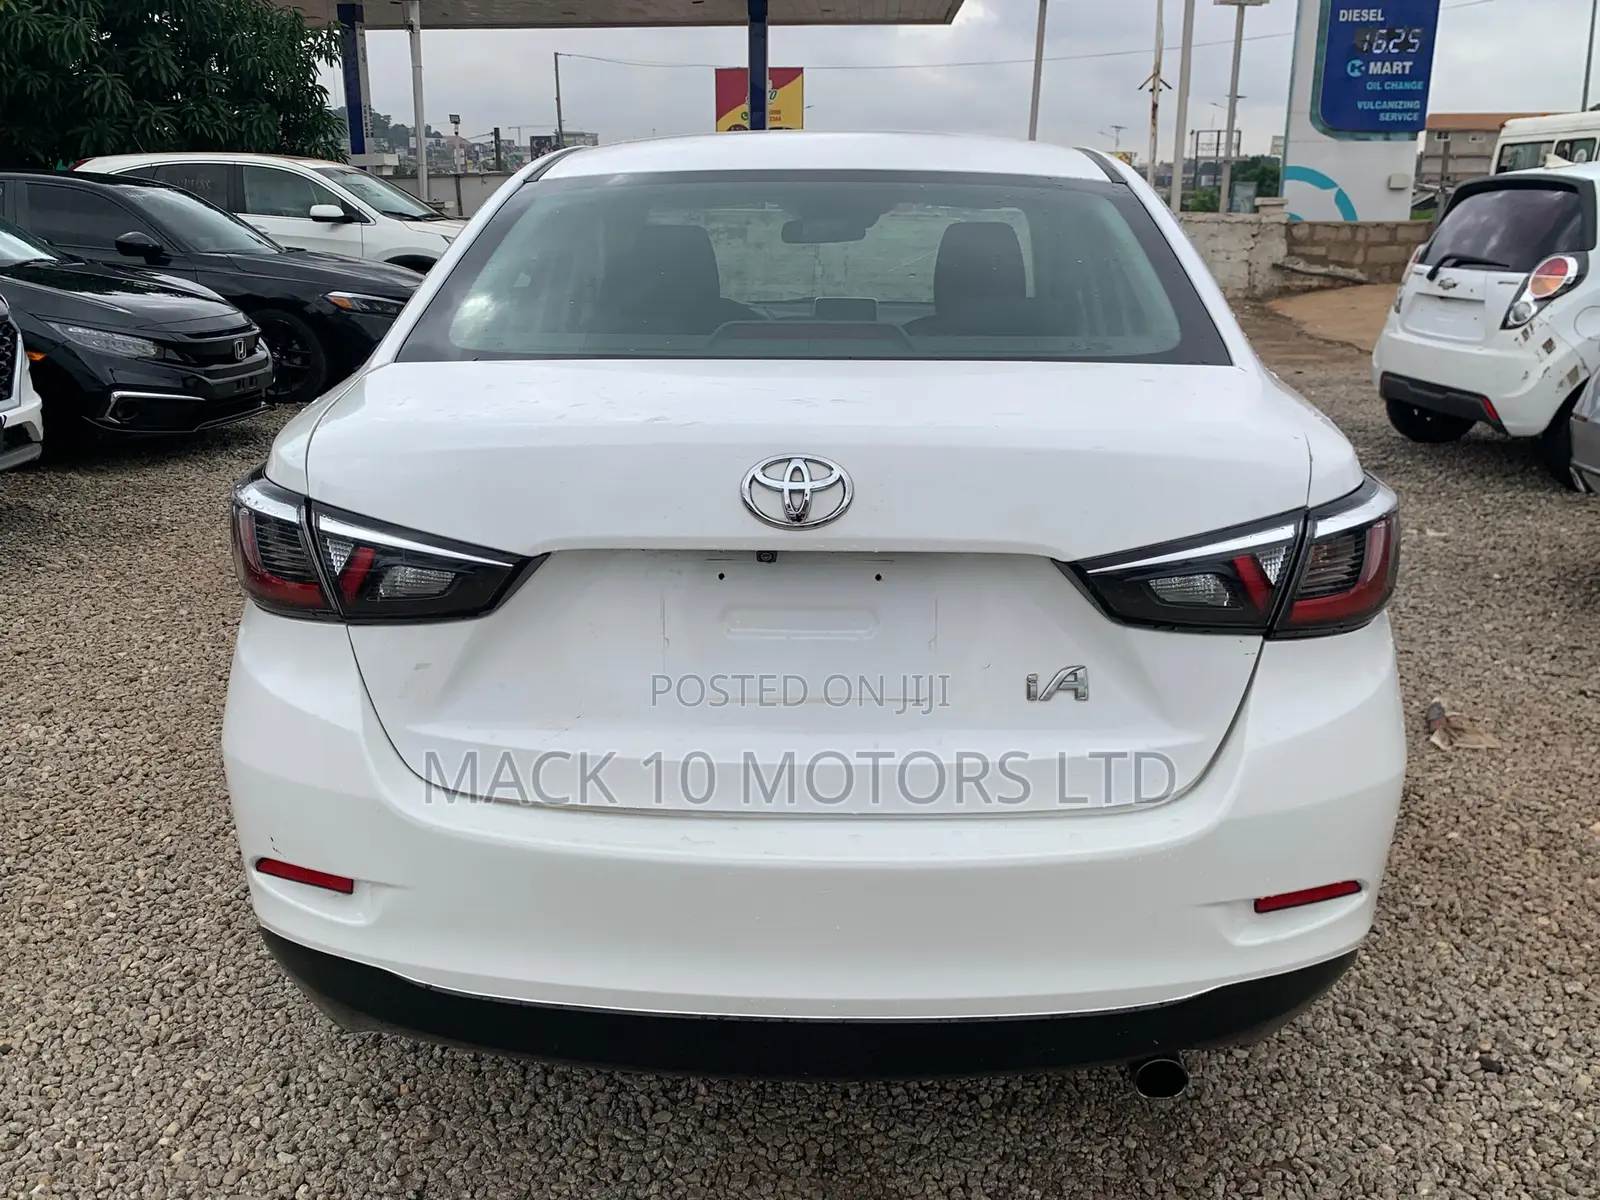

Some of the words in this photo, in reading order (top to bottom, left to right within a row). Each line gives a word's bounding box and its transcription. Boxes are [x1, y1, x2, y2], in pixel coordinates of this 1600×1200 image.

[1339, 9, 1385, 22] DIESEL
[1368, 61, 1413, 75] MART
[1366, 81, 1383, 91] OIL
[1384, 81, 1424, 90] CHANGE
[1357, 101, 1421, 110] VULCANIZING
[1379, 112, 1420, 122] SERVICE
